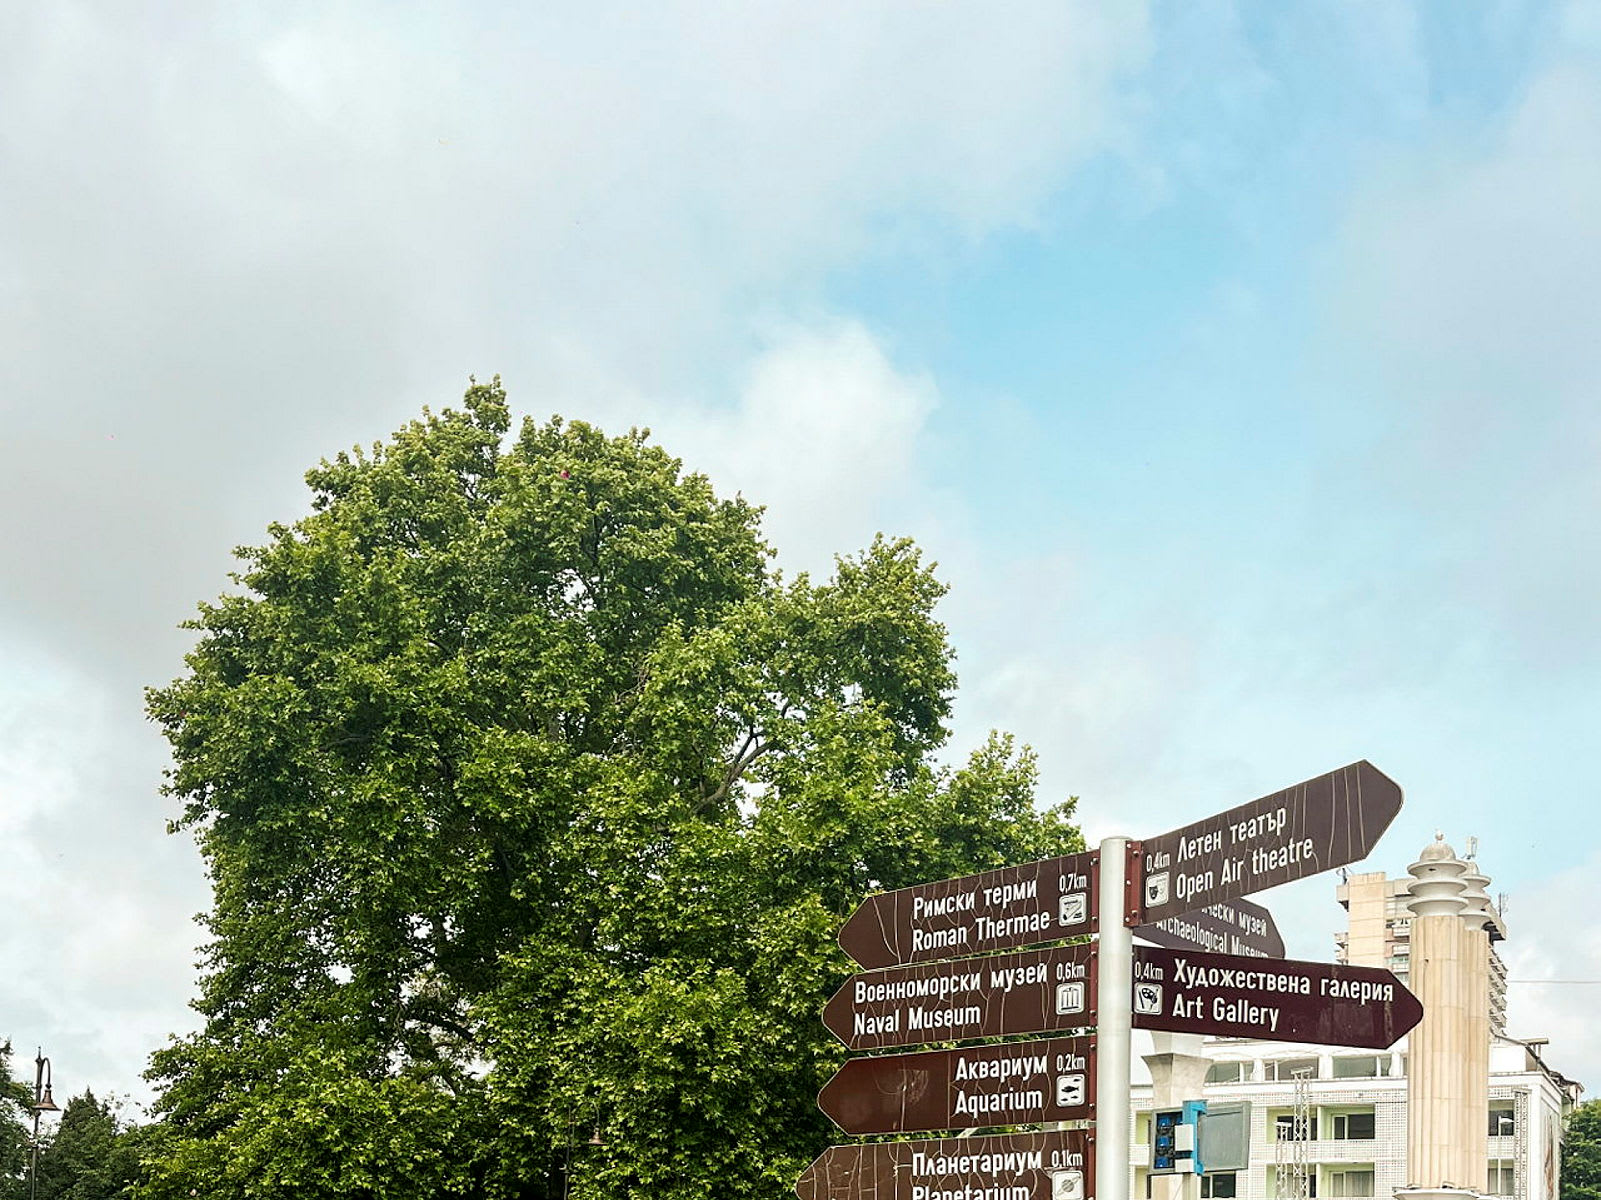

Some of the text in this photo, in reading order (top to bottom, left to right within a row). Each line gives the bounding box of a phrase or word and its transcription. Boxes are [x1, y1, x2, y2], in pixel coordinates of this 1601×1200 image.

[1177, 807, 1287, 863] Летен театър
[1058, 873, 1087, 894] 0,7km
[1176, 837, 1313, 903] Open Air theatre
[913, 880, 1037, 920] Римски терми
[912, 911, 1050, 952] Roman Thermae
[854, 963, 1048, 1003] Военноморски музей
[1056, 961, 1085, 982] 0,6km
[1134, 961, 1164, 982] 0,4km
[1173, 957, 1394, 1005] Художествена галерия
[854, 1005, 981, 1035] Naval Museum
[1172, 994, 1280, 1032] Art Gallery
[955, 1055, 1048, 1083] Аквариум
[1056, 1053, 1086, 1073] 0,2km
[955, 1087, 1043, 1119] Aquarium
[912, 1151, 1042, 1178] Планетариум
